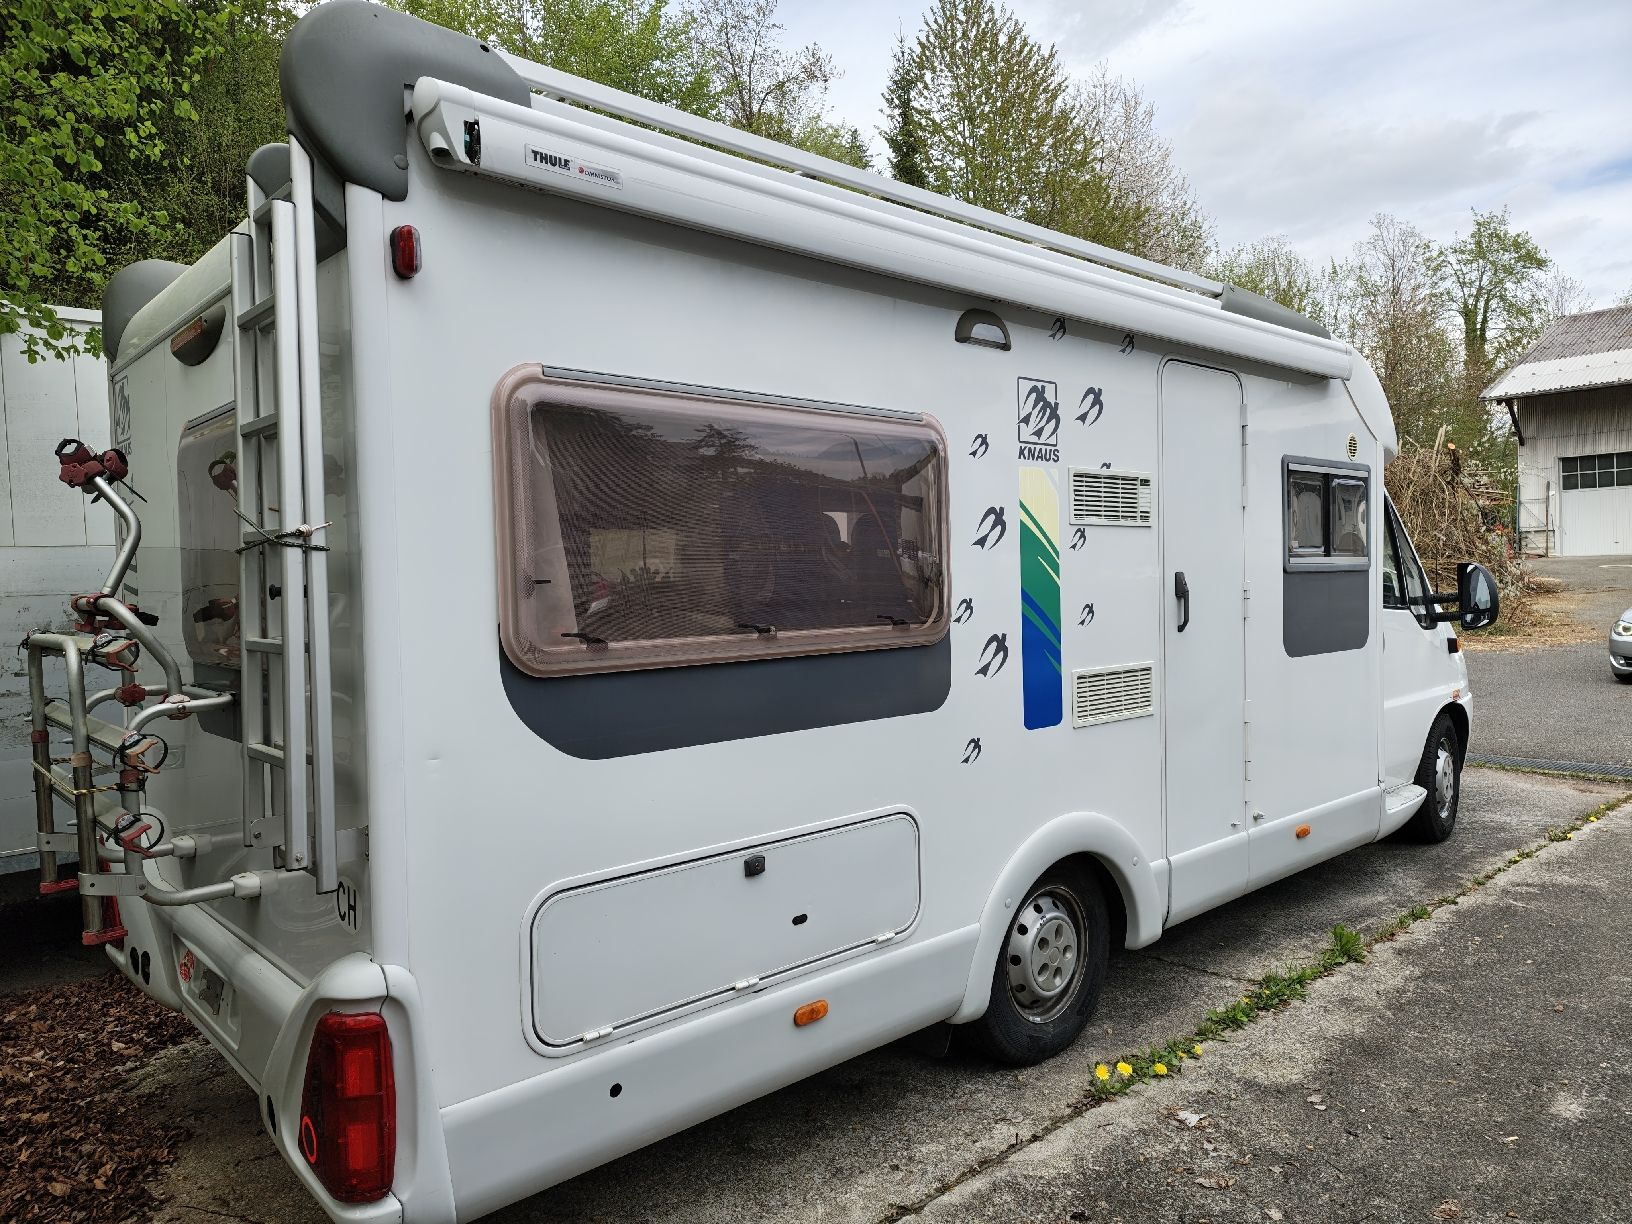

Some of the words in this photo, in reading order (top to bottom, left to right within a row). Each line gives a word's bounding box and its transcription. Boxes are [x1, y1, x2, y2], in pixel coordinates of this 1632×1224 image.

[531, 149, 571, 171] THULE
[1018, 445, 1060, 463] KNAUS
[337, 881, 357, 931] CH
